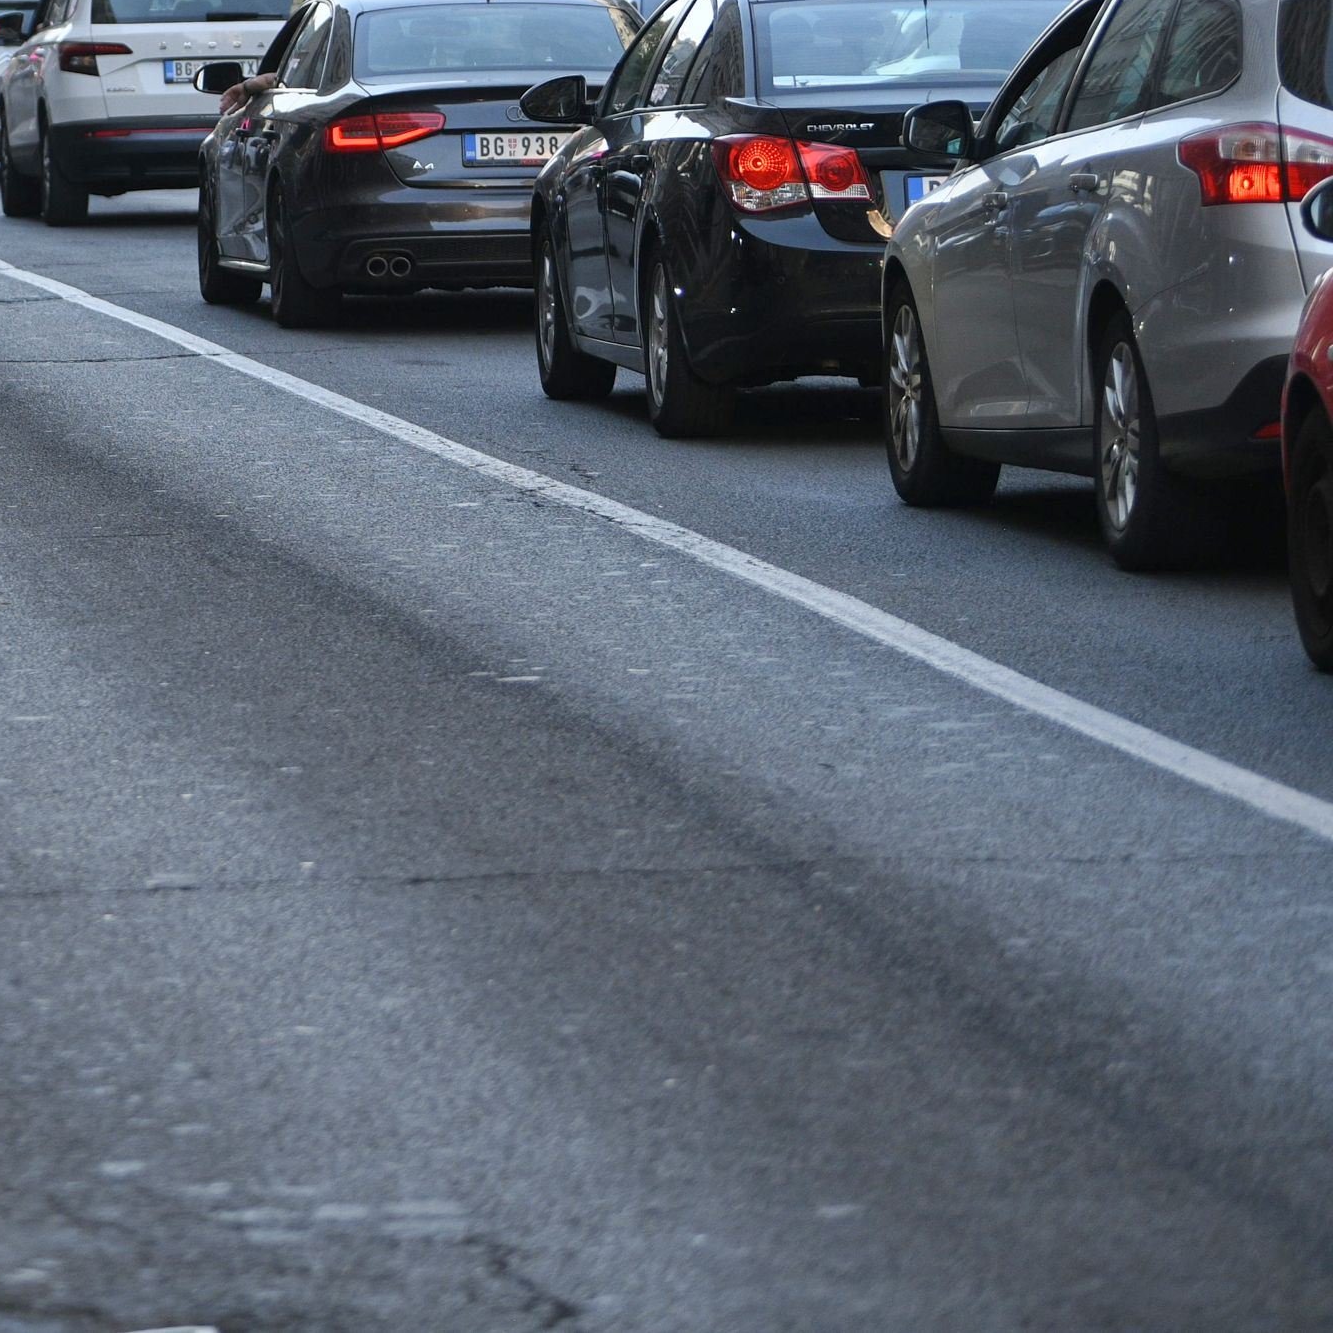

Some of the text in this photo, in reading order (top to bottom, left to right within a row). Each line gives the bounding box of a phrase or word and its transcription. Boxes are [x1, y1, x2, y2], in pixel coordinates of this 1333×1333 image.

[175, 62, 192, 76] BG
[807, 123, 875, 132] CHEVROLET
[480, 137, 504, 156] BG
[413, 160, 434, 170] A4
